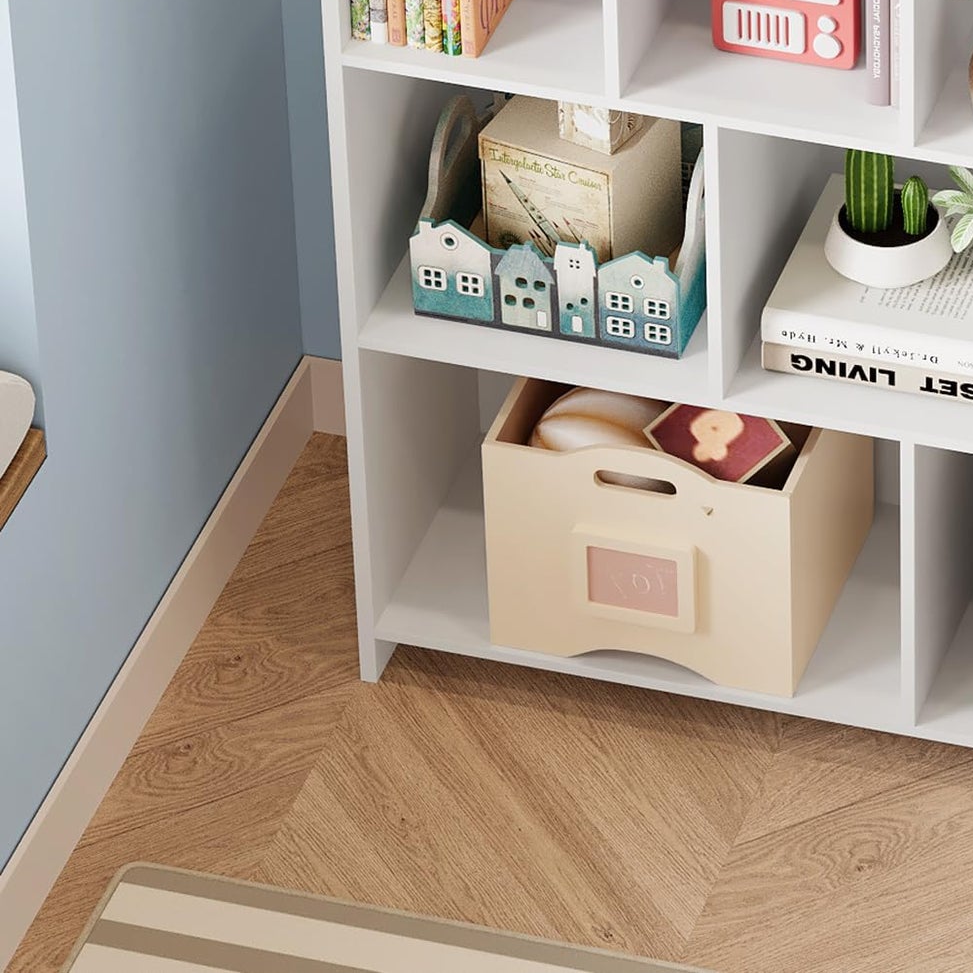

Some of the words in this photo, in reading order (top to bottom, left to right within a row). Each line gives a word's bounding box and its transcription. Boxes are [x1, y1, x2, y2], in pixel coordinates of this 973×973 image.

[489, 147, 544, 174] Intergalactic
[544, 163, 566, 181] Star
[568, 170, 602, 191] Cruiser
[781, 330, 817, 343] Hyde
[823, 337, 848, 349] Mr.
[855, 342, 865, 353] &
[790, 353, 896, 386] LIVING
